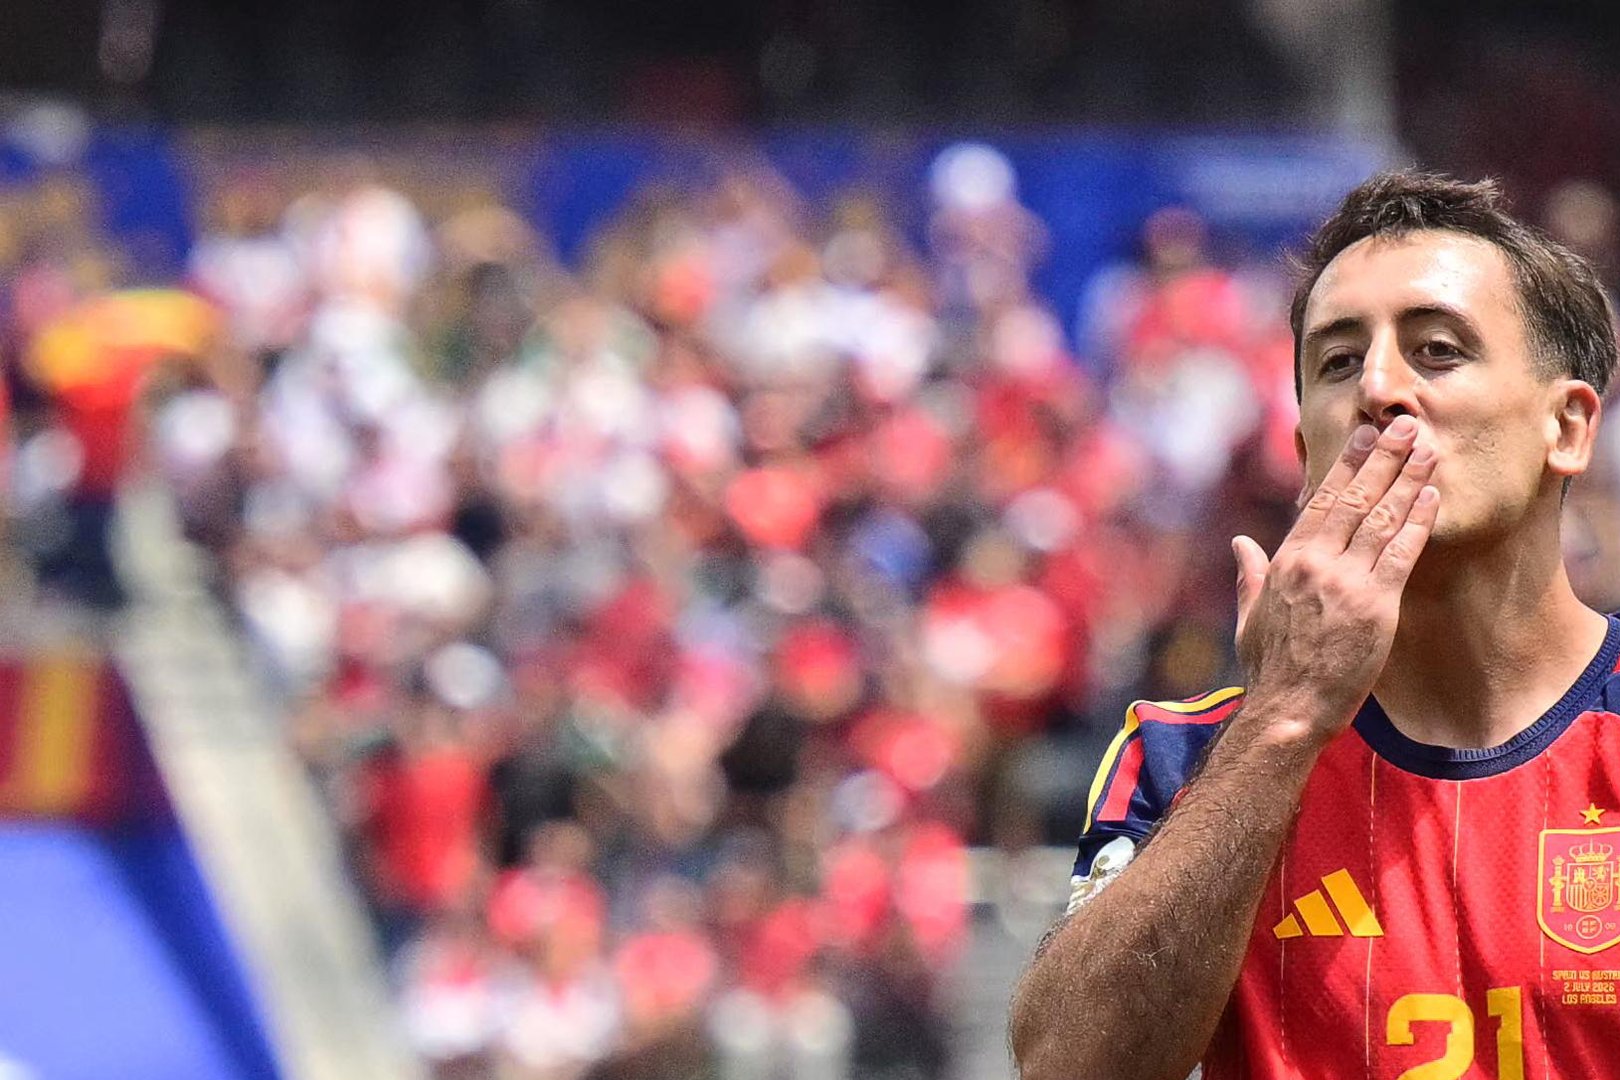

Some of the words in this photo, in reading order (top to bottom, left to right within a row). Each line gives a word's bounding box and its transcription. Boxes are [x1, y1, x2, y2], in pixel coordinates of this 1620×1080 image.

[1564, 982, 1570, 992] 2
[1572, 982, 1590, 992] JULY
[1592, 982, 1615, 992] 2026
[1562, 994, 1578, 1004] LOS
[1580, 994, 1617, 1004] ANGELES
